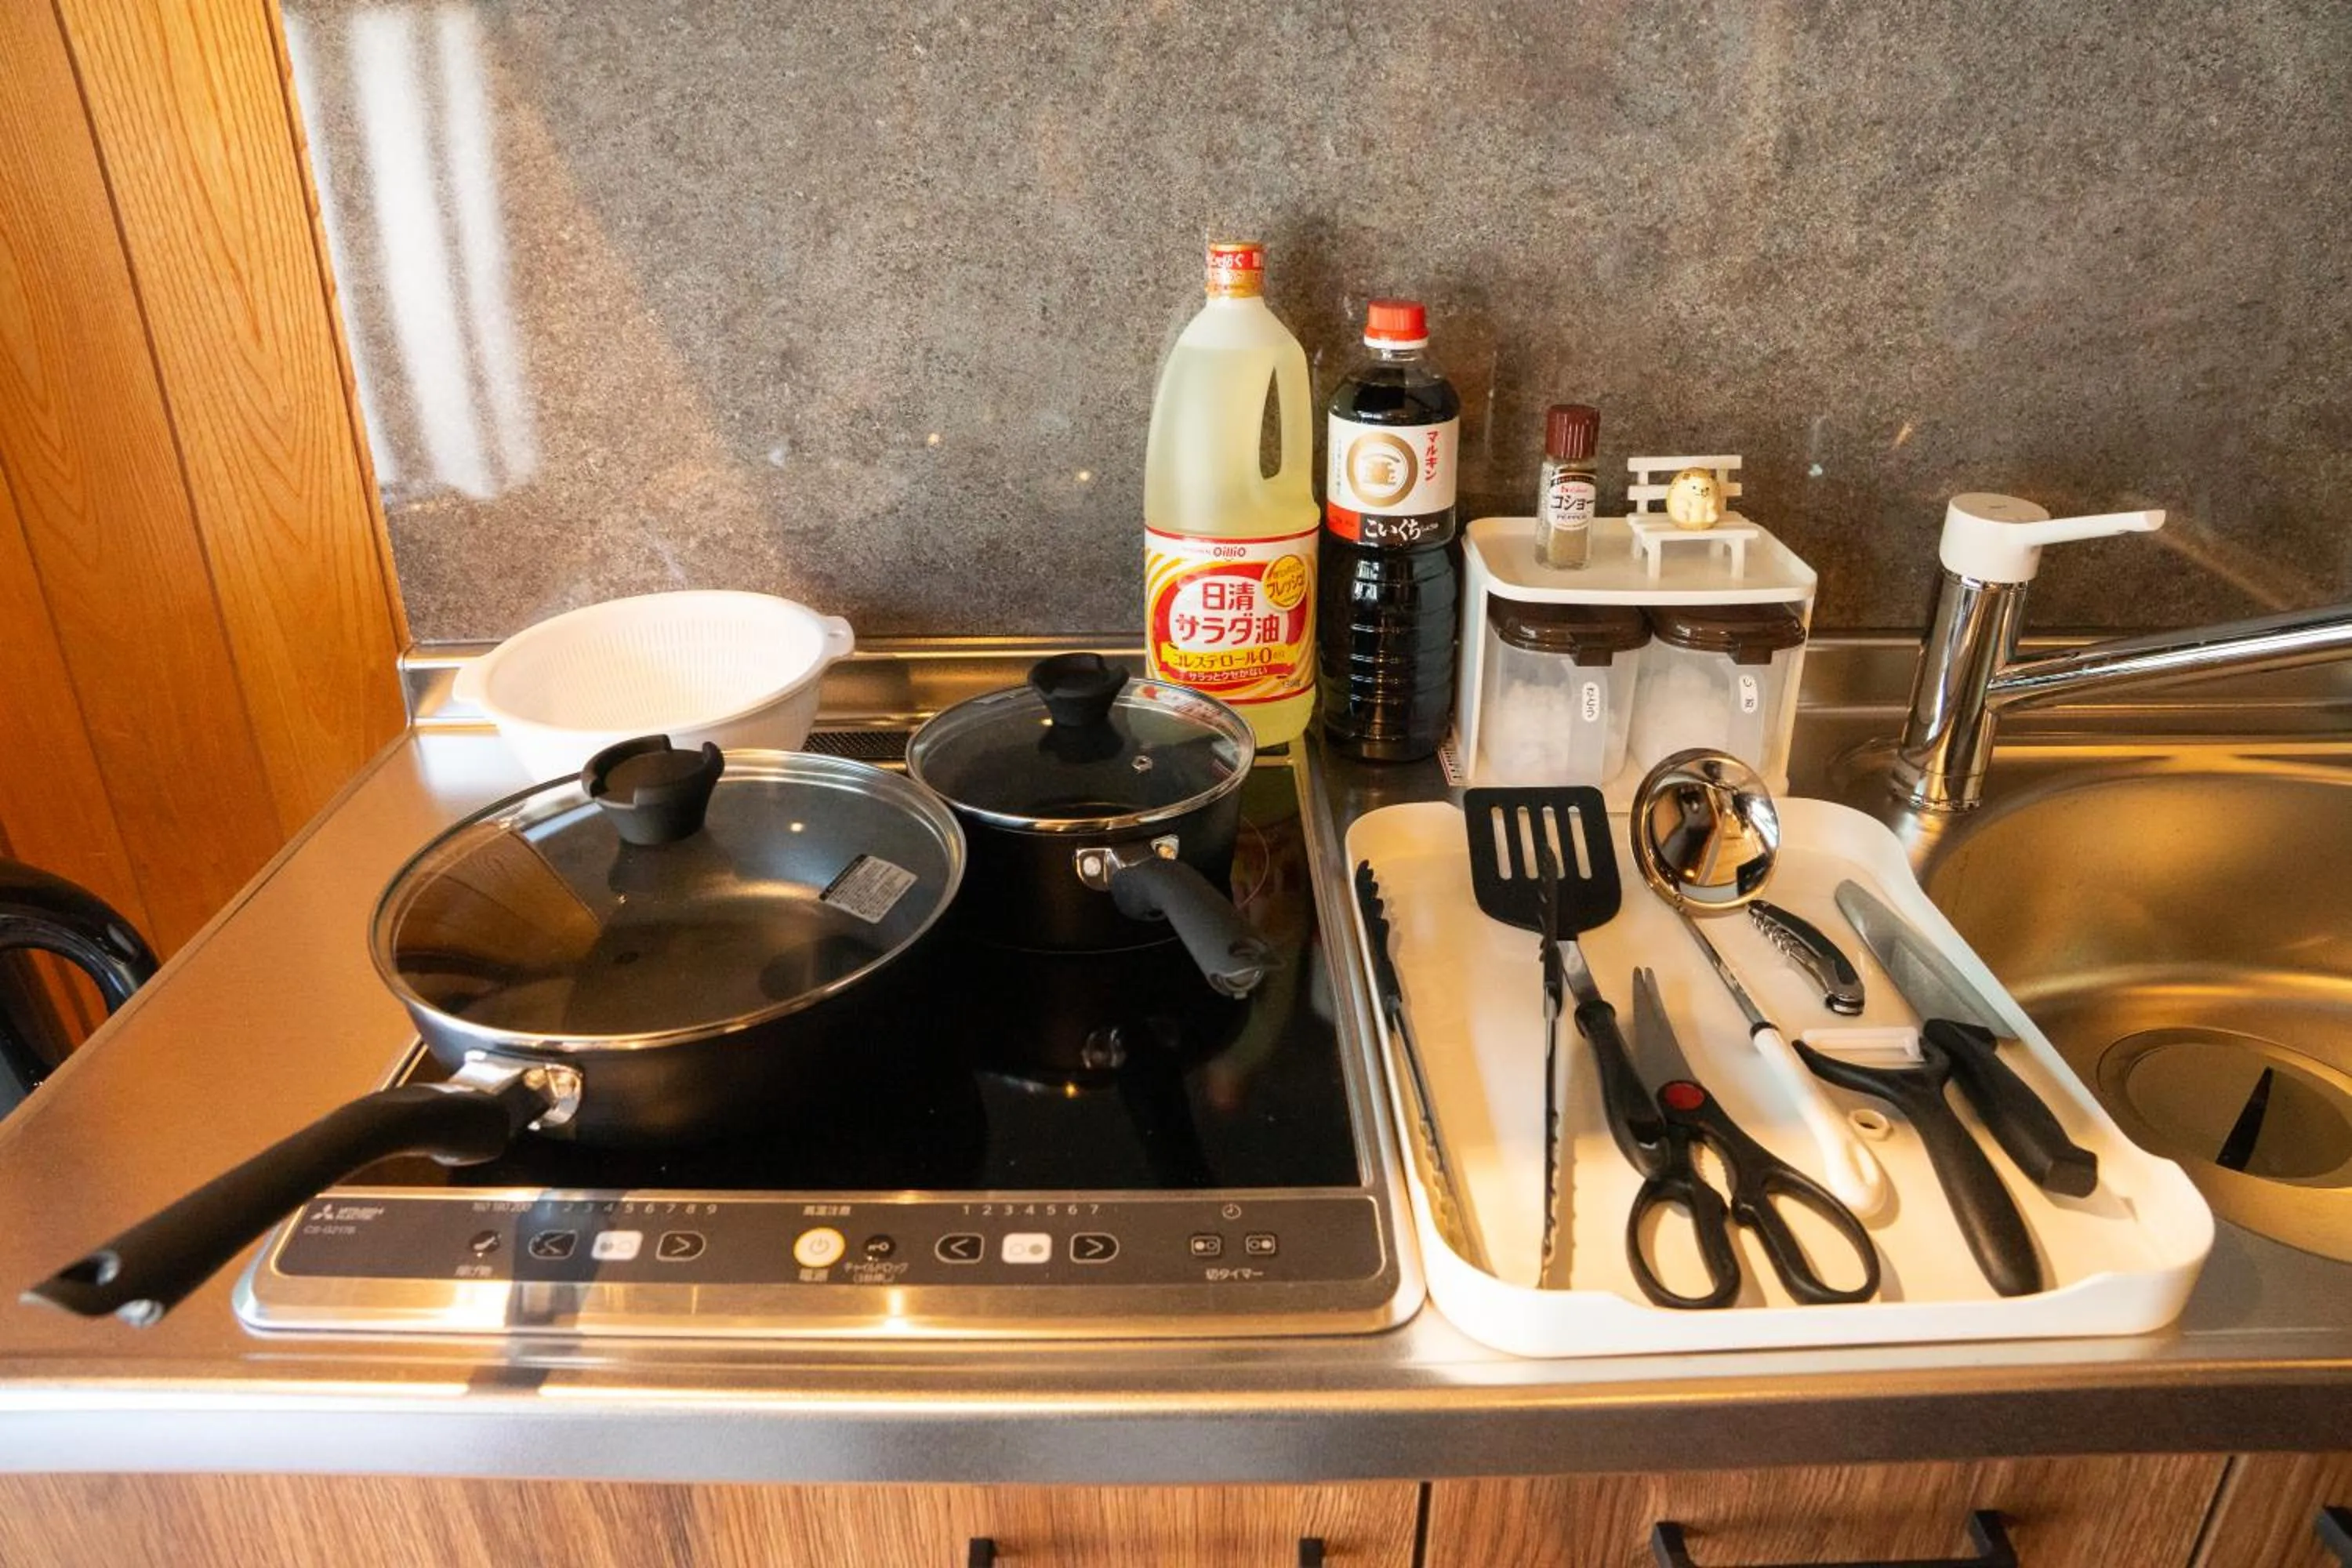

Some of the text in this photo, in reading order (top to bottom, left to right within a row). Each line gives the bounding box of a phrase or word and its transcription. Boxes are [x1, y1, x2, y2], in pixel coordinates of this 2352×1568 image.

[1425, 430, 1439, 481] マルキン
[1550, 495, 1595, 510] コショー
[1364, 518, 1422, 541] こいくち
[1202, 581, 1254, 611] 日清
[1176, 612, 1280, 645] サラダ油
